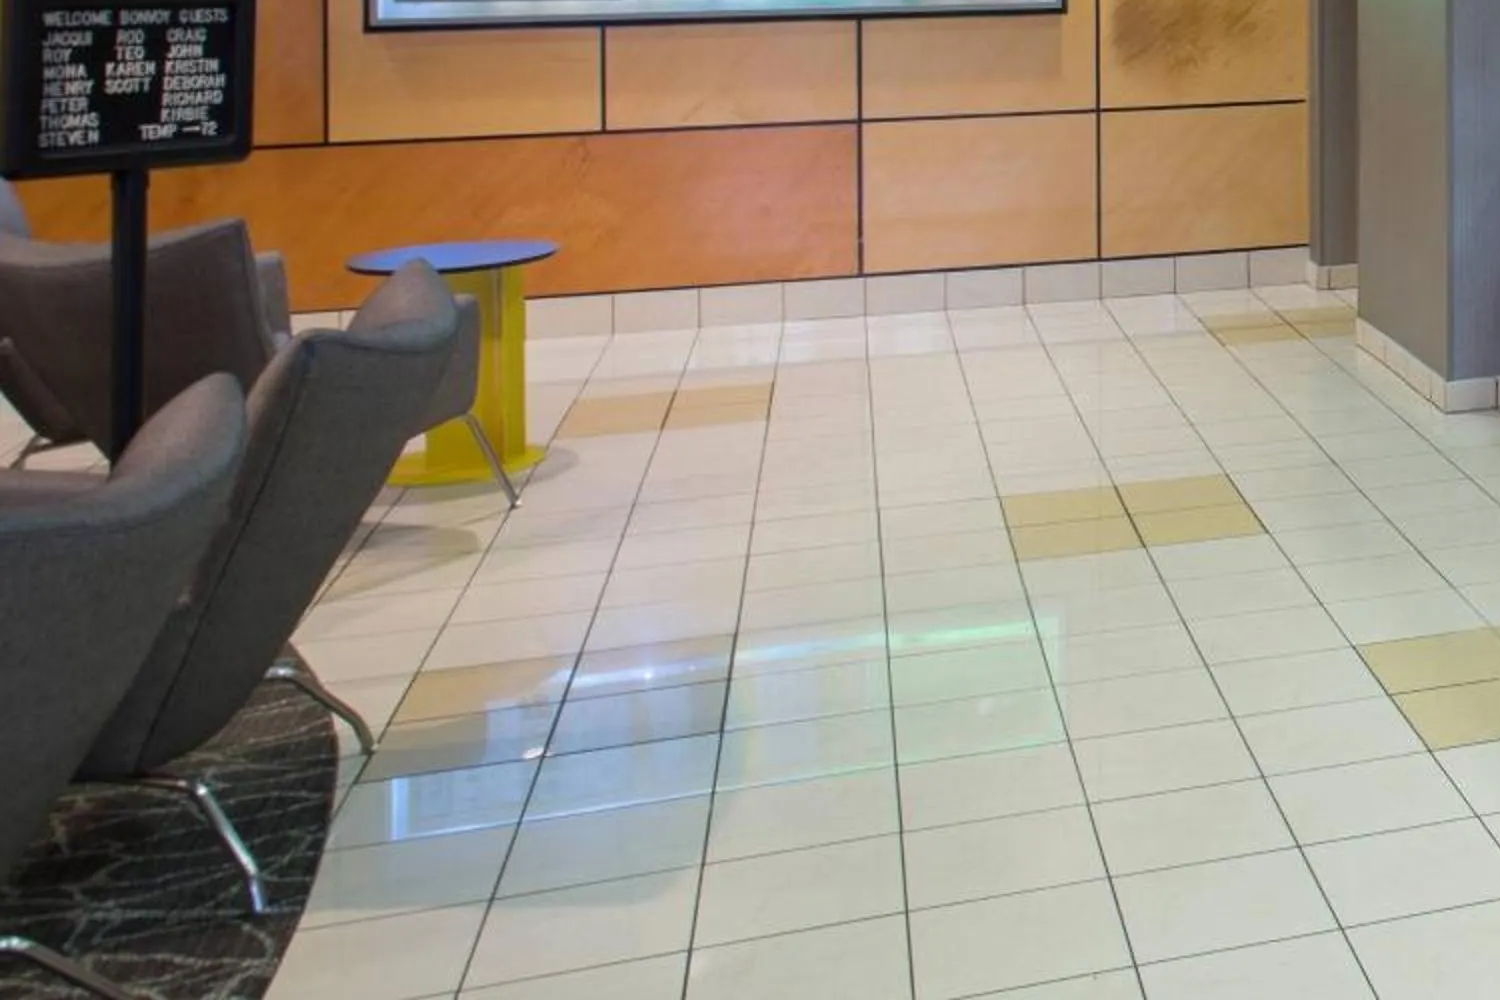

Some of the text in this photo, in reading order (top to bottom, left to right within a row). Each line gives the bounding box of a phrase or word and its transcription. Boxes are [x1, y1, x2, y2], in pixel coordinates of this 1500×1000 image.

[43, 8, 228, 27] WELCOME BONVOY GUESTS
[165, 27, 208, 43] CRAIG
[42, 48, 72, 62] ROY
[165, 44, 203, 59] JOHN
[43, 64, 88, 79] MONA
[104, 61, 156, 77] KAREN
[164, 59, 219, 75] KRISTIN
[43, 79, 94, 96] HENRY
[104, 77, 152, 94] SCOTT
[162, 73, 226, 90] DEBORAH
[41, 98, 88, 114] PETER
[162, 90, 223, 106] RICHARD
[40, 112, 99, 130] THOMAS
[37, 130, 99, 148] STEVEN
[138, 124, 177, 140] TEMP
